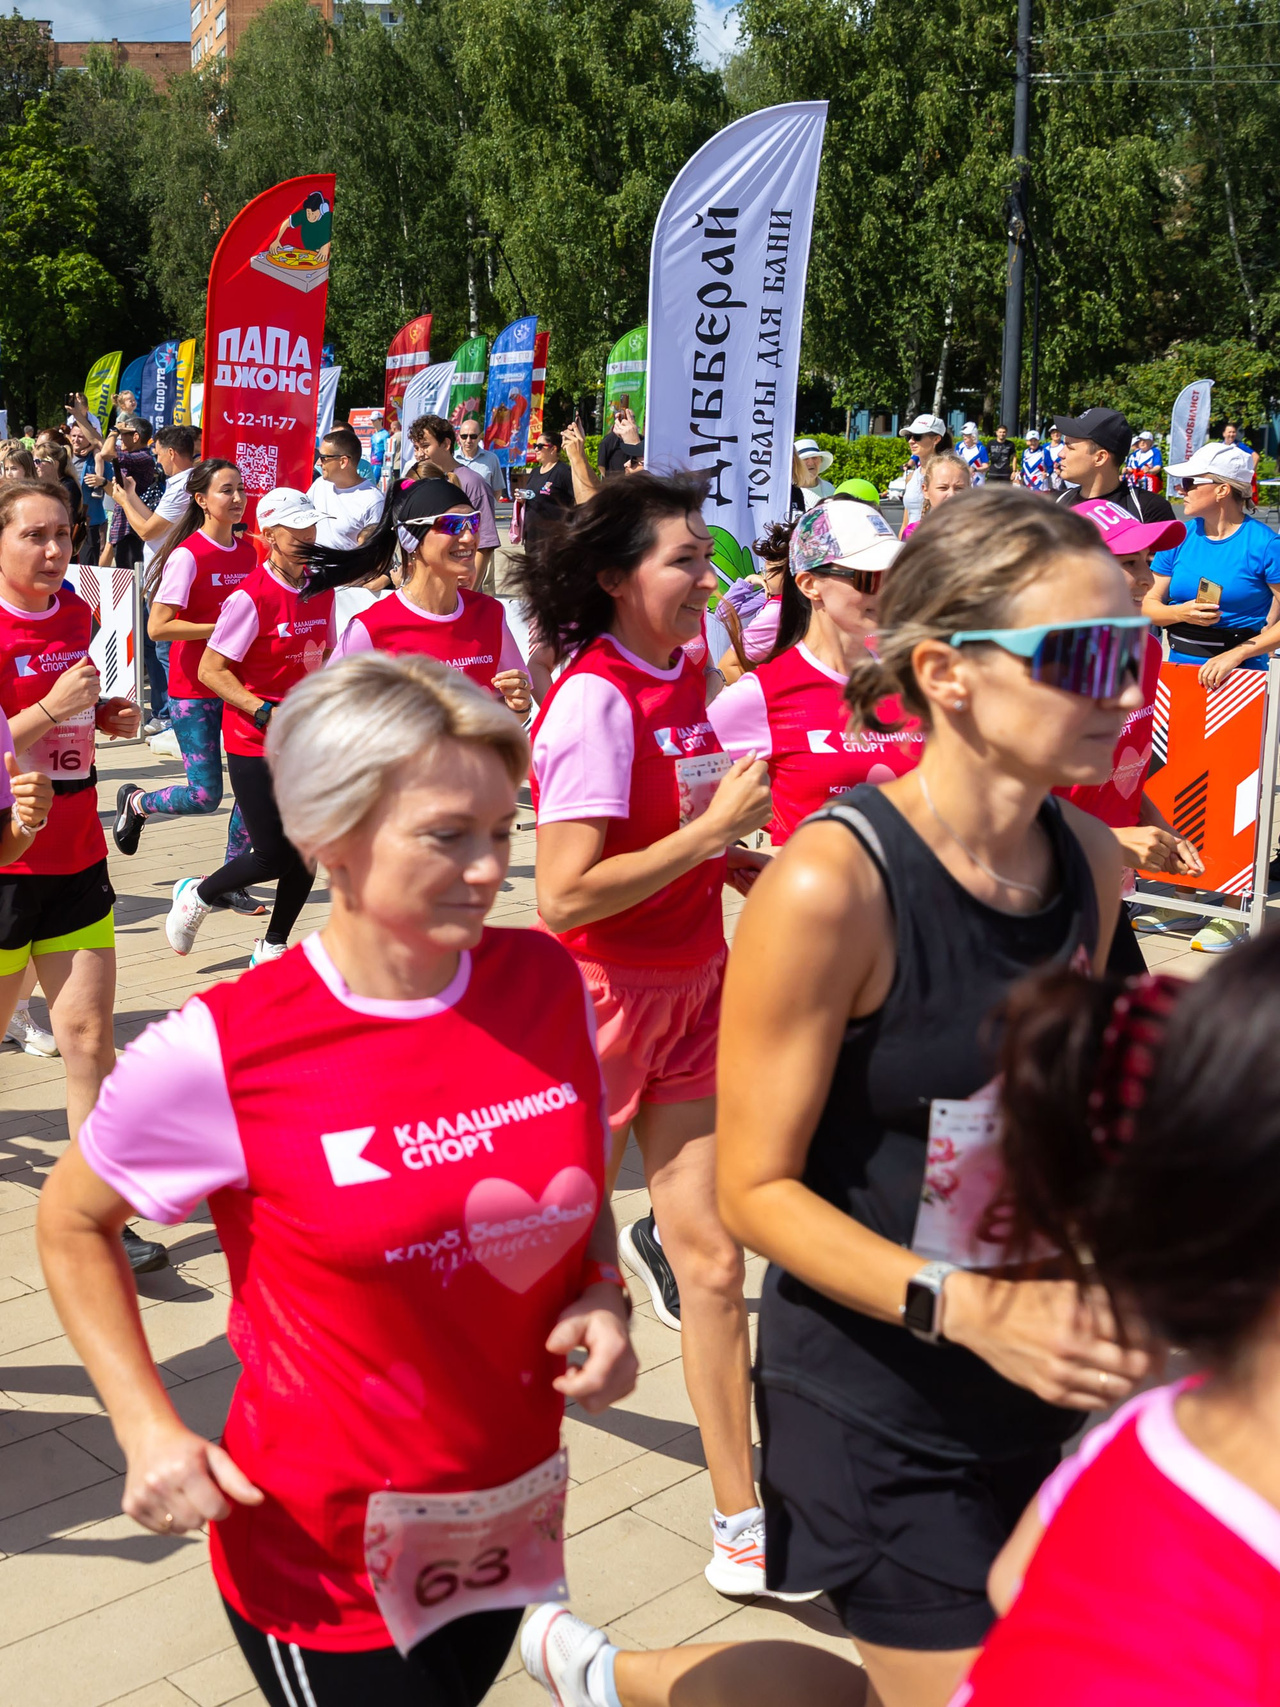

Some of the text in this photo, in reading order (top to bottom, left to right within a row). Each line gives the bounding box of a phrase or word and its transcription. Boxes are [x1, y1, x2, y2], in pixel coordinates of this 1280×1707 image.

[217, 326, 312, 370] ПАПА
[748, 208, 793, 508] ТОВАРЫ ДЛЯ БАНИ
[155, 367, 167, 412] Спорта
[214, 364, 312, 395] ДЖОНС
[237, 412, 297, 431] 22-11-77
[295, 627, 312, 635] СПОРТ
[41, 662, 69, 673] СПОРТ
[48, 749, 81, 771] 16
[842, 741, 886, 754] СПОРТ
[393, 1082, 578, 1148] КАЛАШНИКОВ
[402, 1131, 495, 1170] СПОРТ
[384, 1203, 594, 1263] клуб беговых
[415, 1546, 510, 1608] 63
